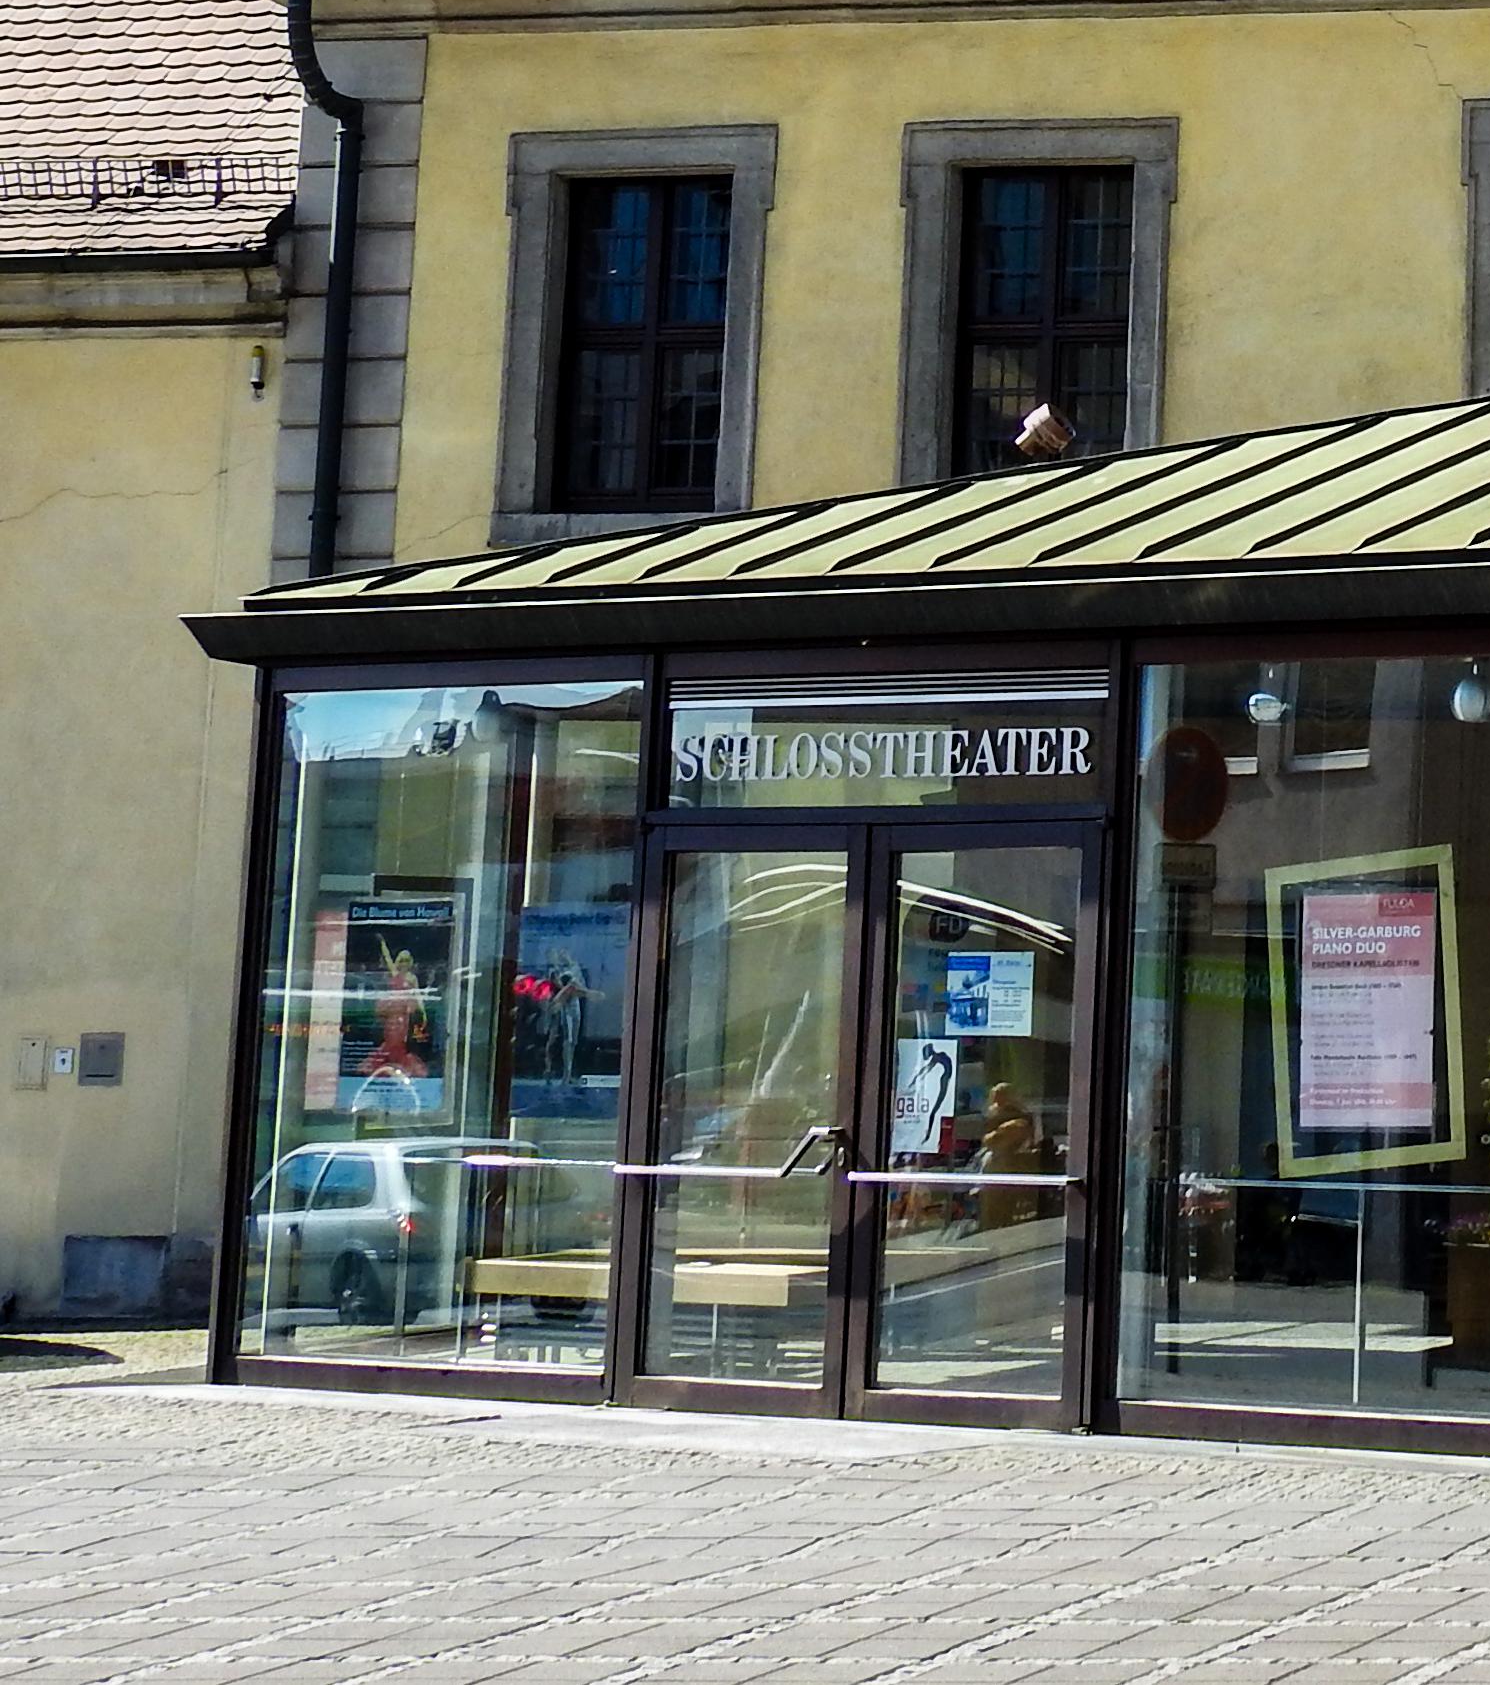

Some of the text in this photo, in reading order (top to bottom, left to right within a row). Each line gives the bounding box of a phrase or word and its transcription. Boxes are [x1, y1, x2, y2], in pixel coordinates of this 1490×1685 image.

[675, 726, 1092, 782] SCHLOSSTHEATER
[1312, 925, 1421, 939] SILVER-GARBURG
[1312, 941, 1387, 955] PIANO DUO
[896, 1093, 930, 1119] gala
